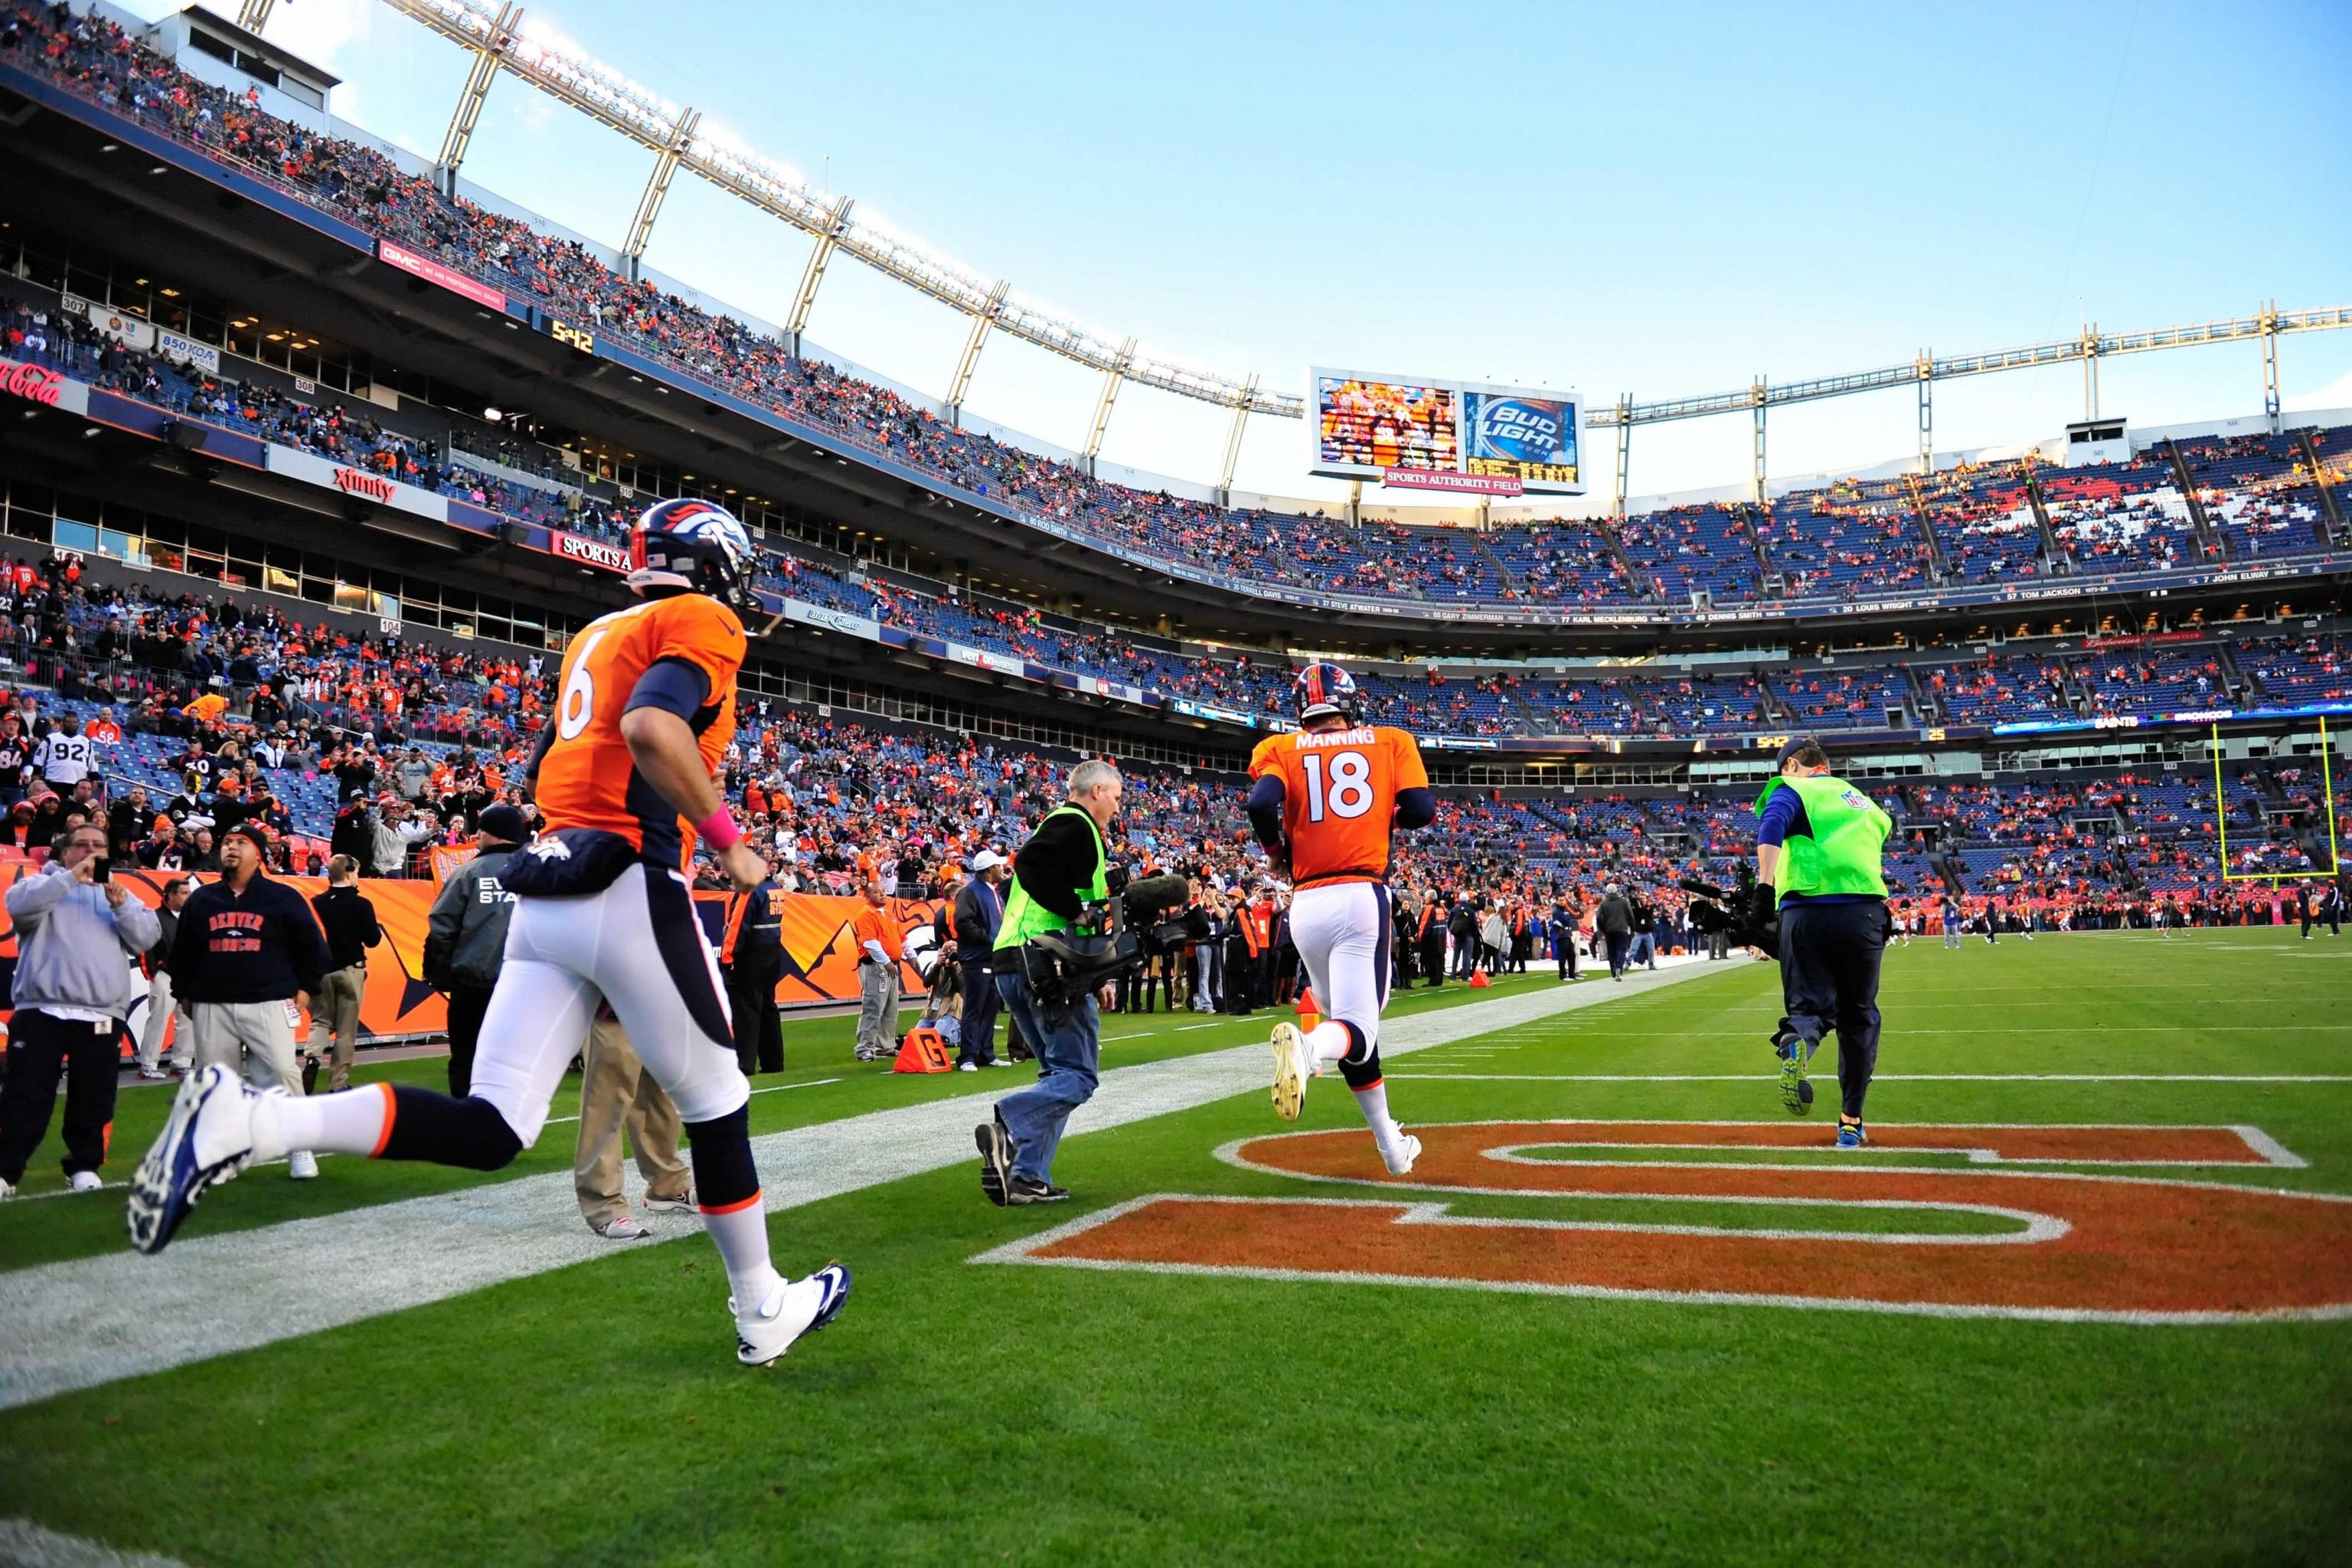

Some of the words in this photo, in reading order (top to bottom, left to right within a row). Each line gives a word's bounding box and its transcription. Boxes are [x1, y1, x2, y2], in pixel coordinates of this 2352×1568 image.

[383, 145, 395, 154] 509
[534, 217, 546, 227] 510
[383, 247, 420, 270] GMC
[434, 270, 446, 281] ARE
[688, 289, 697, 299] 511
[63, 298, 84, 312] 307
[162, 335, 187, 351] 850
[552, 320, 593, 354] 5:42
[296, 379, 314, 393] 308
[1491, 405, 1558, 434] BUD
[1481, 422, 1560, 451] LIGHT
[334, 468, 397, 504] xfinity
[1387, 472, 1427, 484] SPORTS
[1429, 475, 1491, 490] AUTHORITY
[1493, 481, 1521, 492] FIELD
[620, 488, 633, 498] 310
[754, 529, 764, 538] 311
[1029, 518, 1037, 526] 80
[1037, 519, 1049, 531] ROD
[1050, 522, 1068, 537] SMITH
[563, 537, 621, 568] SPORTS
[1125, 550, 1149, 566] SHANNON
[1150, 558, 1171, 573] SHARPE
[21, 573, 31, 583] 18
[2213, 573, 2237, 583] JOHN
[2239, 570, 2269, 580] ELWAY
[1240, 584, 1263, 597] TERRELL
[1263, 590, 1282, 599] DAVIS
[2007, 592, 2017, 600] 57
[2020, 590, 2039, 599] TOM
[2041, 587, 2081, 597] JACKSON
[1331, 601, 1349, 611] STEVE
[1349, 603, 1380, 613] ATWATER
[1842, 605, 1854, 613] 20
[1855, 603, 1880, 612] LOUIS
[1881, 601, 1914, 611] WRIGHT
[267, 618, 274, 627] 7
[807, 609, 831, 622] BUD
[835, 615, 862, 631] LIGHT
[1442, 612, 1462, 620] GARY
[1462, 612, 1504, 622] ZIMMERMAN
[1593, 615, 1648, 623] MECKLENBURG
[1707, 612, 1738, 622] DENNIS
[1738, 611, 1762, 621] SMITH
[383, 620, 400, 635] 104
[2085, 637, 2141, 648] Budweiser
[962, 648, 995, 669] verizon
[559, 628, 610, 742] 6
[384, 691, 394, 702] 18
[2095, 716, 2138, 729] SAINTS
[97, 730, 116, 745] 58
[1295, 729, 1376, 751] MANNING
[1929, 729, 1945, 741] 25
[0, 749, 23, 769] 84
[54, 742, 85, 763] 92
[1302, 750, 1375, 823] 18
[208, 911, 264, 931] DENVER
[920, 1034, 946, 1067] G
